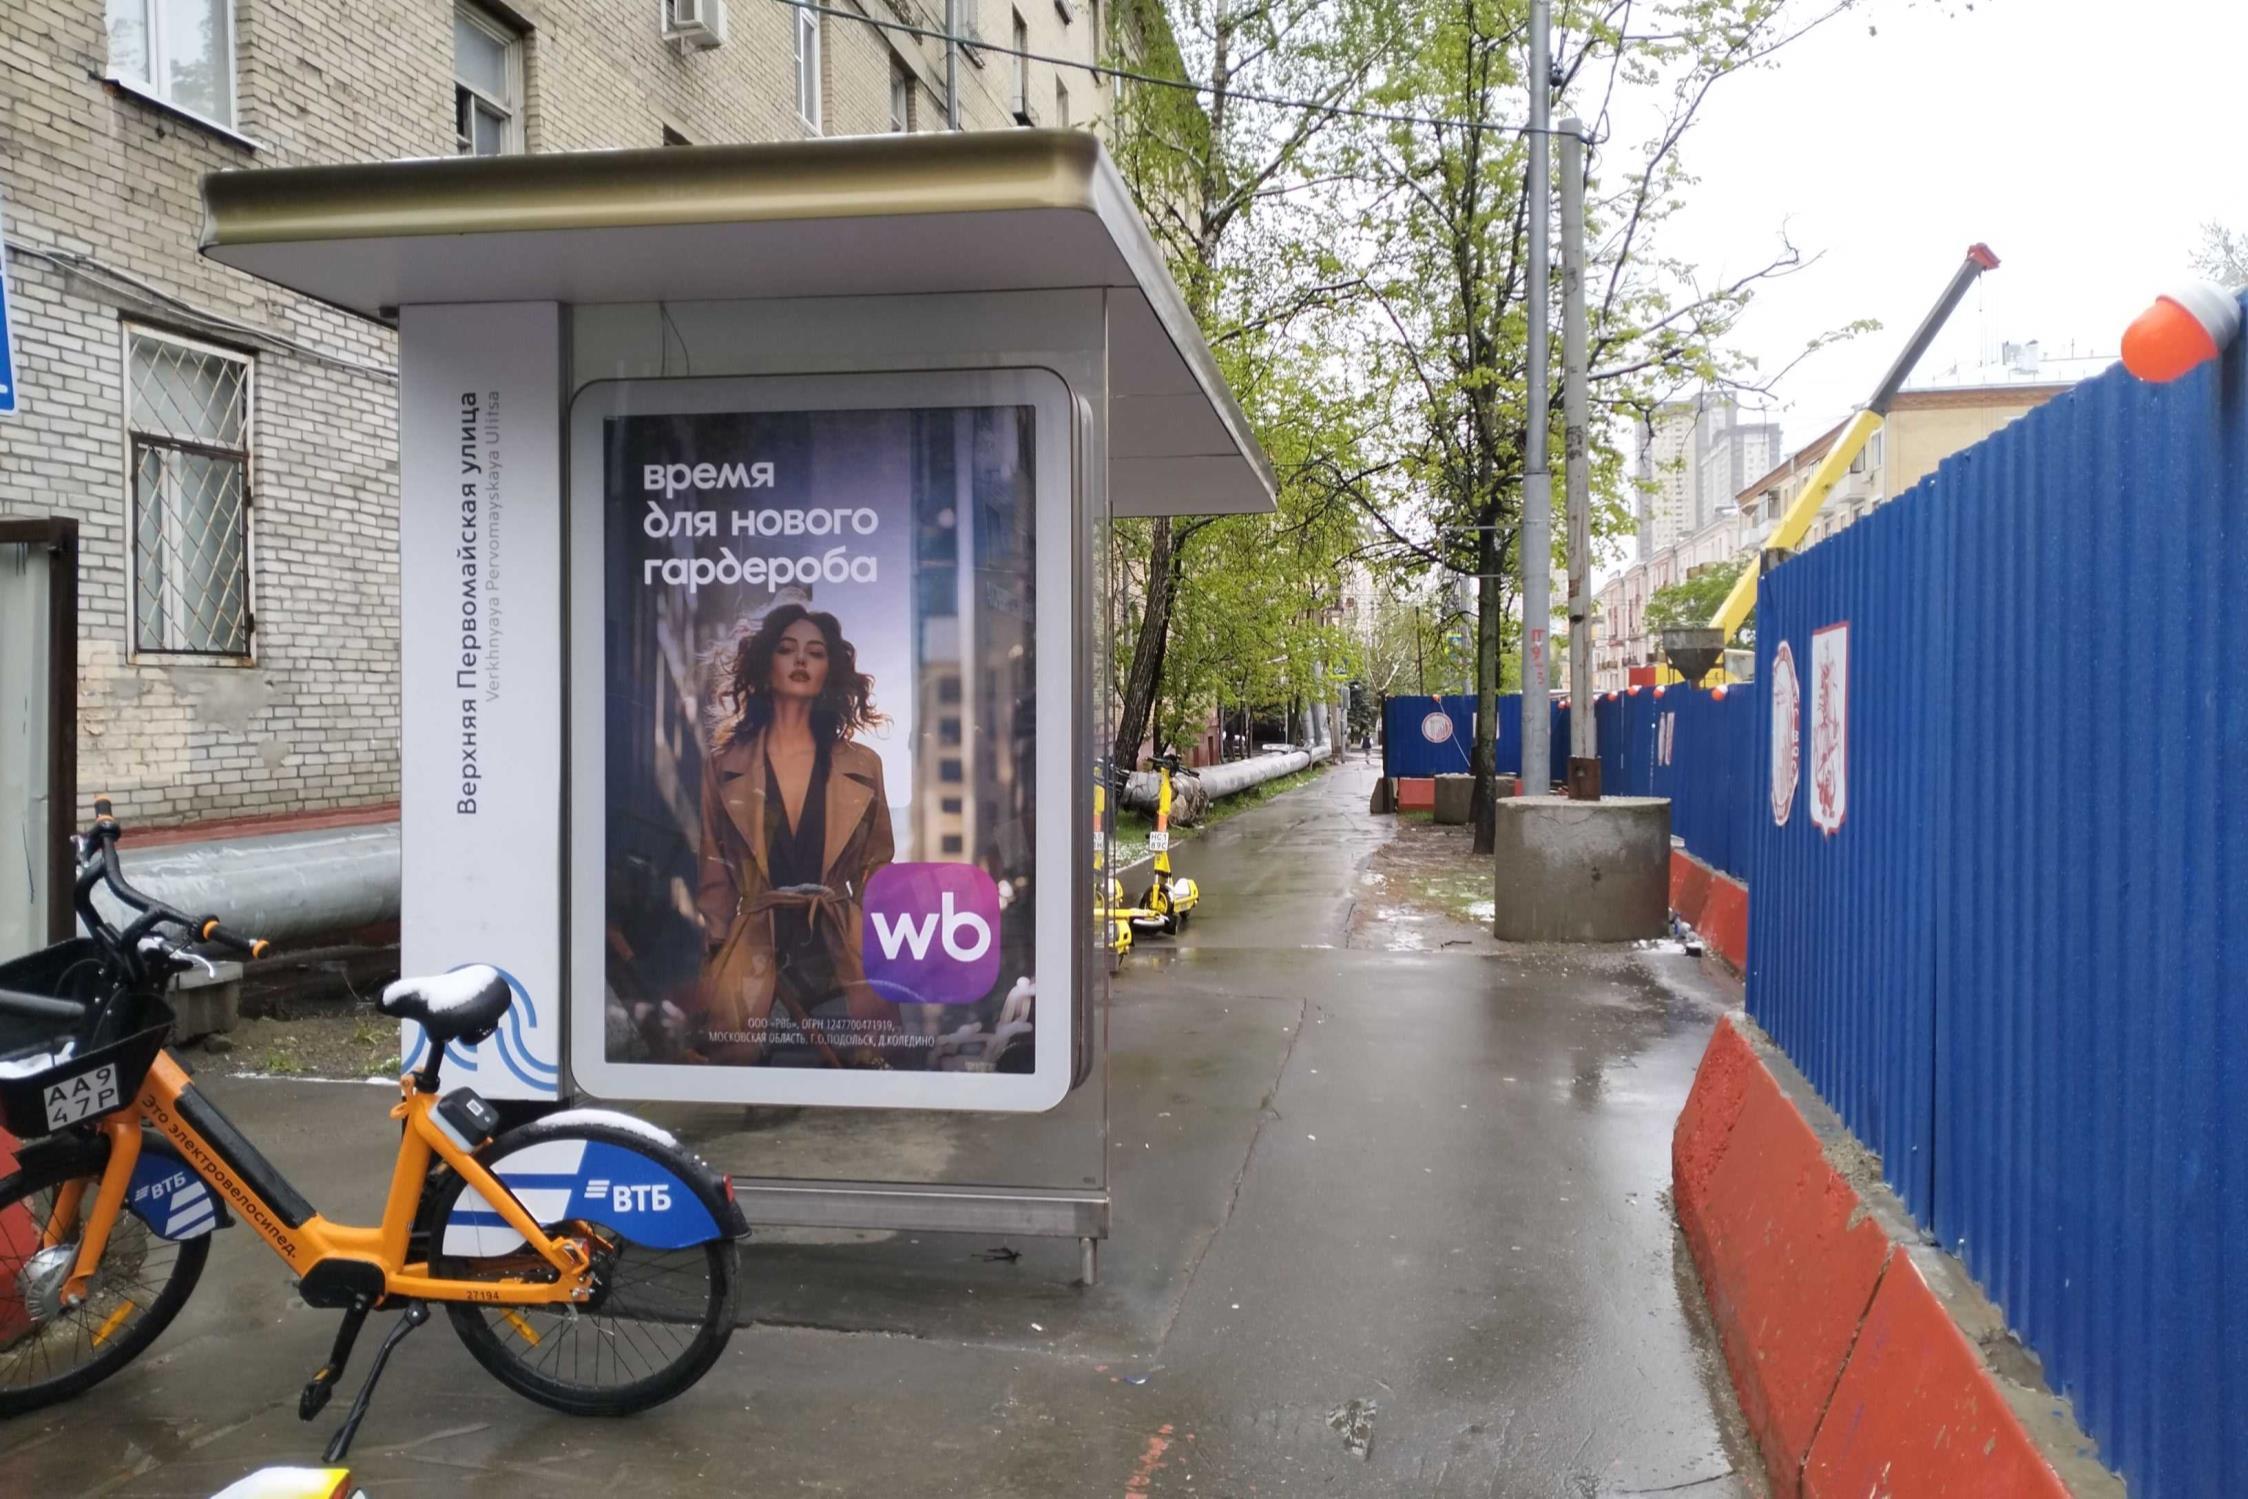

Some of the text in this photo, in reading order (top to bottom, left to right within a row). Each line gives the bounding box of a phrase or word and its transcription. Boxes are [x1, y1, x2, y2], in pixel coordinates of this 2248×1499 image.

[643, 461, 775, 499] время
[643, 500, 879, 538] для нового
[484, 390, 503, 702] Verkhnyaya Pervomayskaya Ulitsa
[643, 545, 878, 594] гардероба
[457, 391, 482, 814] Верхняя Первомайская улица
[870, 891, 992, 963] wb
[708, 1031, 767, 1044] МОСКОВСКАЯ
[768, 1033, 808, 1046] ОБЛАСТЬ,
[748, 1017, 768, 1029] ООО
[801, 1018, 824, 1030] ОГРН
[142, 1094, 297, 1259] Это электровелосипед.
[151, 1171, 187, 1200] ВТБ
[612, 1184, 672, 1213] ВТБ
